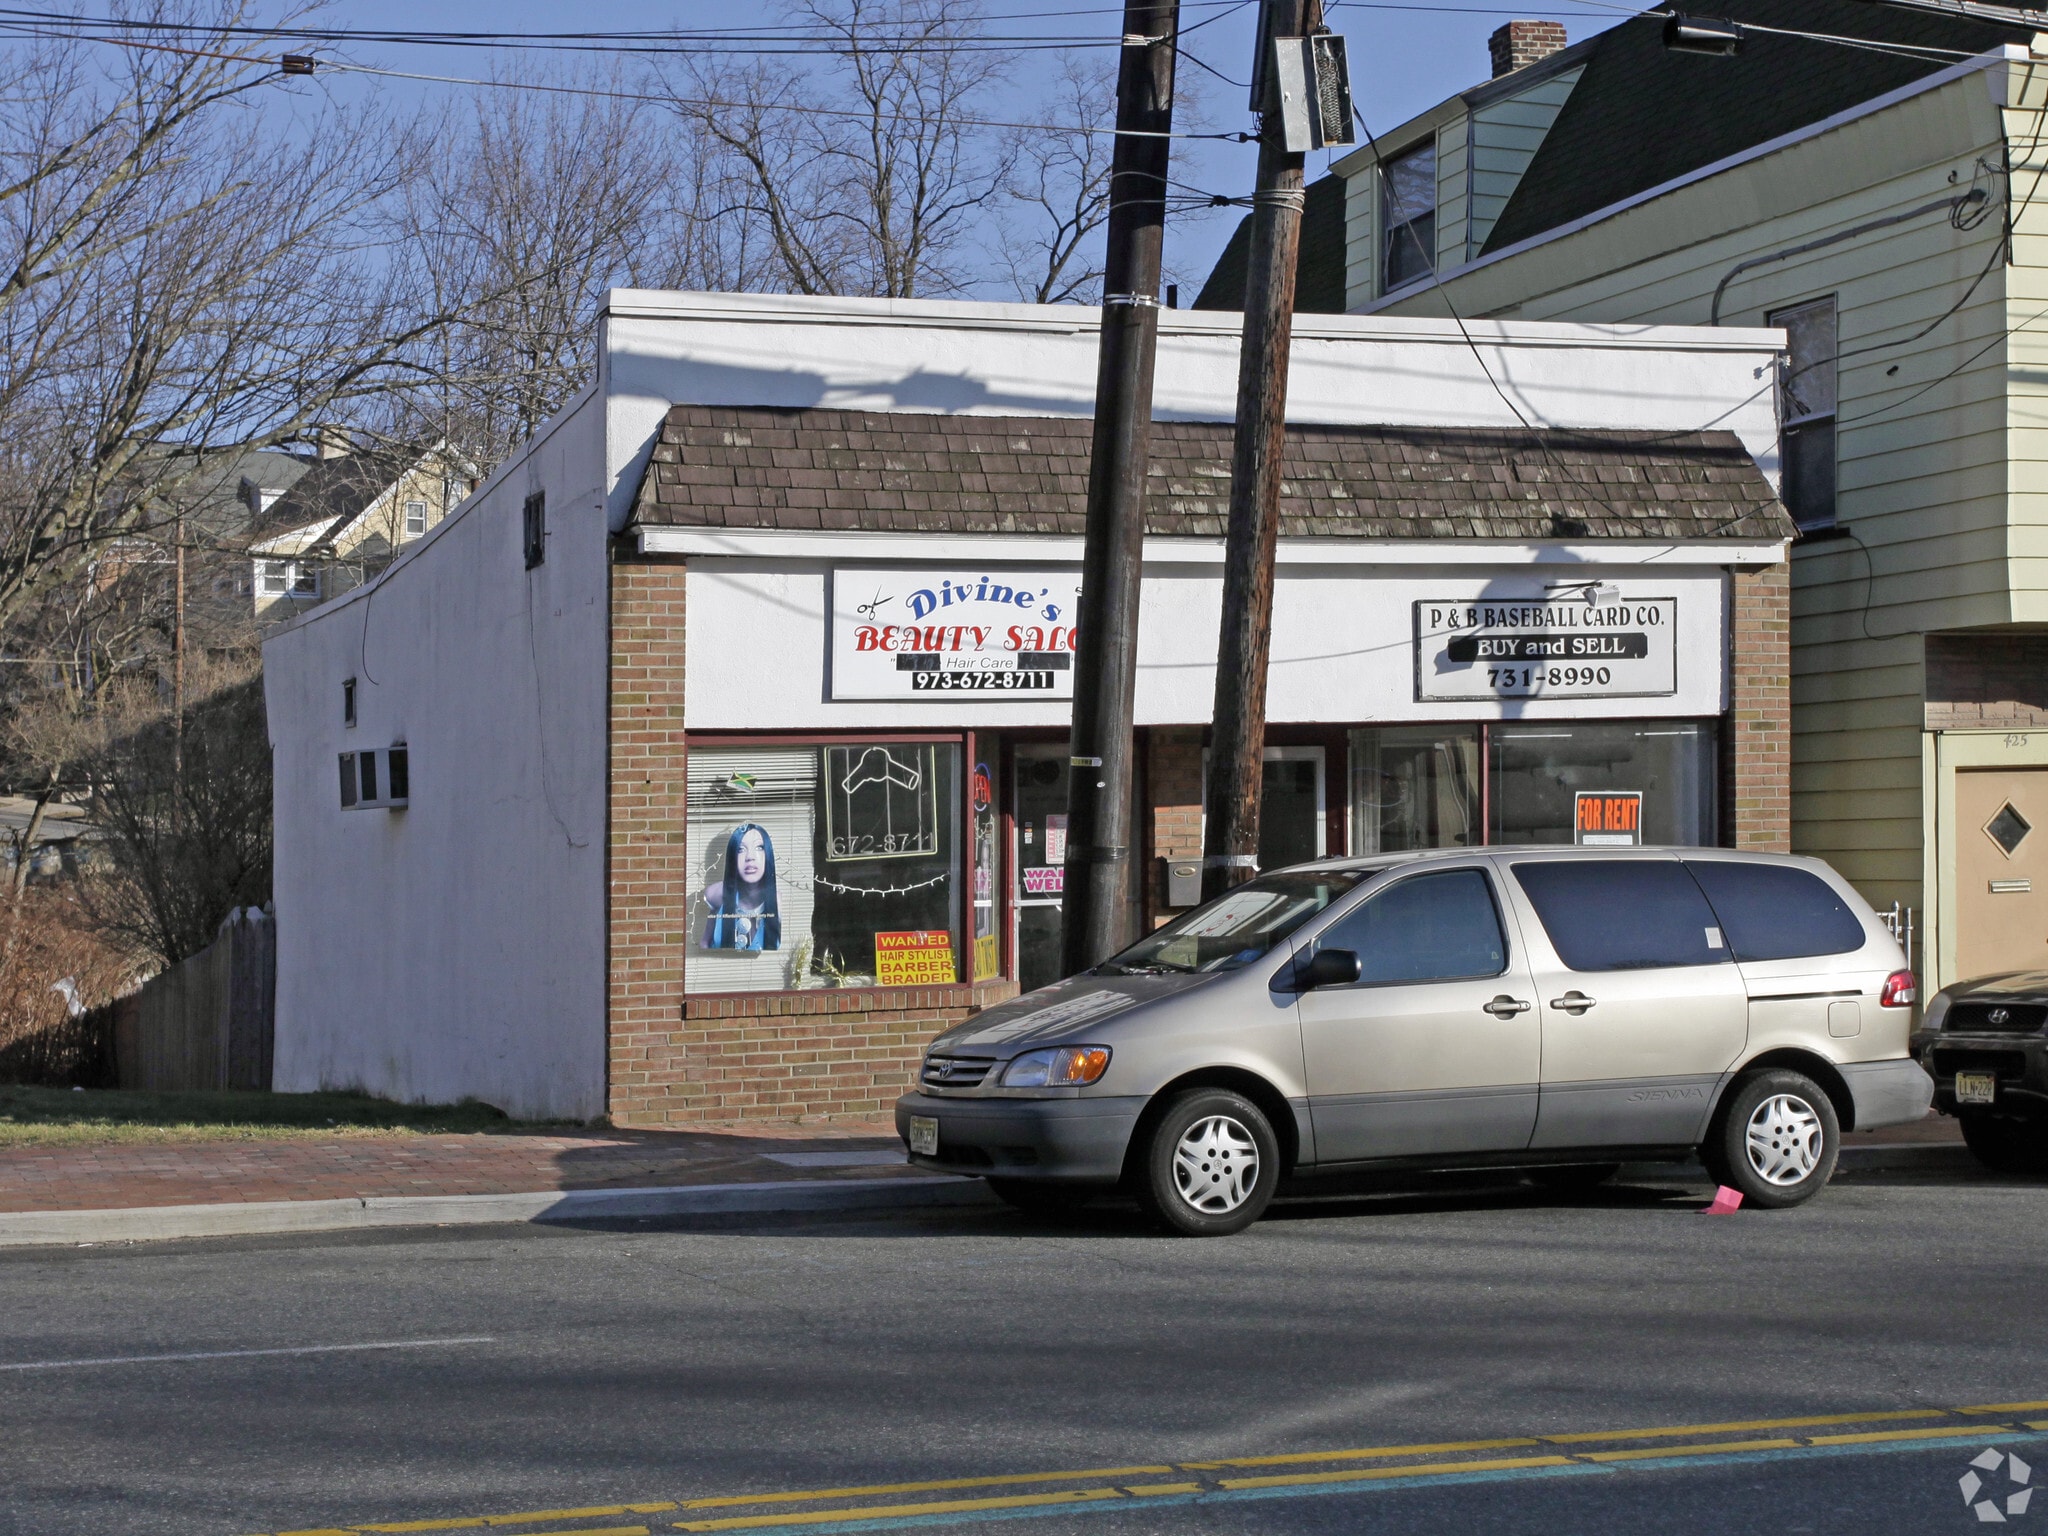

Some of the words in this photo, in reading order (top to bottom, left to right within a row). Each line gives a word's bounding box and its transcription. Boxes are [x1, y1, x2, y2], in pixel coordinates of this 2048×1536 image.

[905, 576, 1062, 621] Divine's
[1430, 608, 1442, 628] P
[1447, 608, 1461, 628] &
[1466, 608, 1478, 627] B
[1484, 606, 1578, 628] BASEBALL
[1582, 606, 1631, 627] CARD
[1636, 606, 1665, 626] CO.
[854, 625, 992, 652] BEAUTY
[1477, 639, 1520, 656] BUY
[1525, 638, 1565, 655] and
[1572, 637, 1626, 655] SELL
[946, 657, 976, 669] Hair
[980, 657, 1014, 669] Care
[916, 672, 1048, 689] 973-672-8711
[1487, 666, 1612, 688] 731-8990
[2003, 733, 2028, 749] 425
[1577, 798, 1602, 831] FOR
[1605, 798, 1640, 831] RENT
[880, 935, 949, 947] WANTED
[880, 951, 905, 961] HAIR
[908, 949, 950, 960] STYLIST
[881, 961, 952, 973] BARBER
[1627, 1088, 1703, 1103] SIENNA
